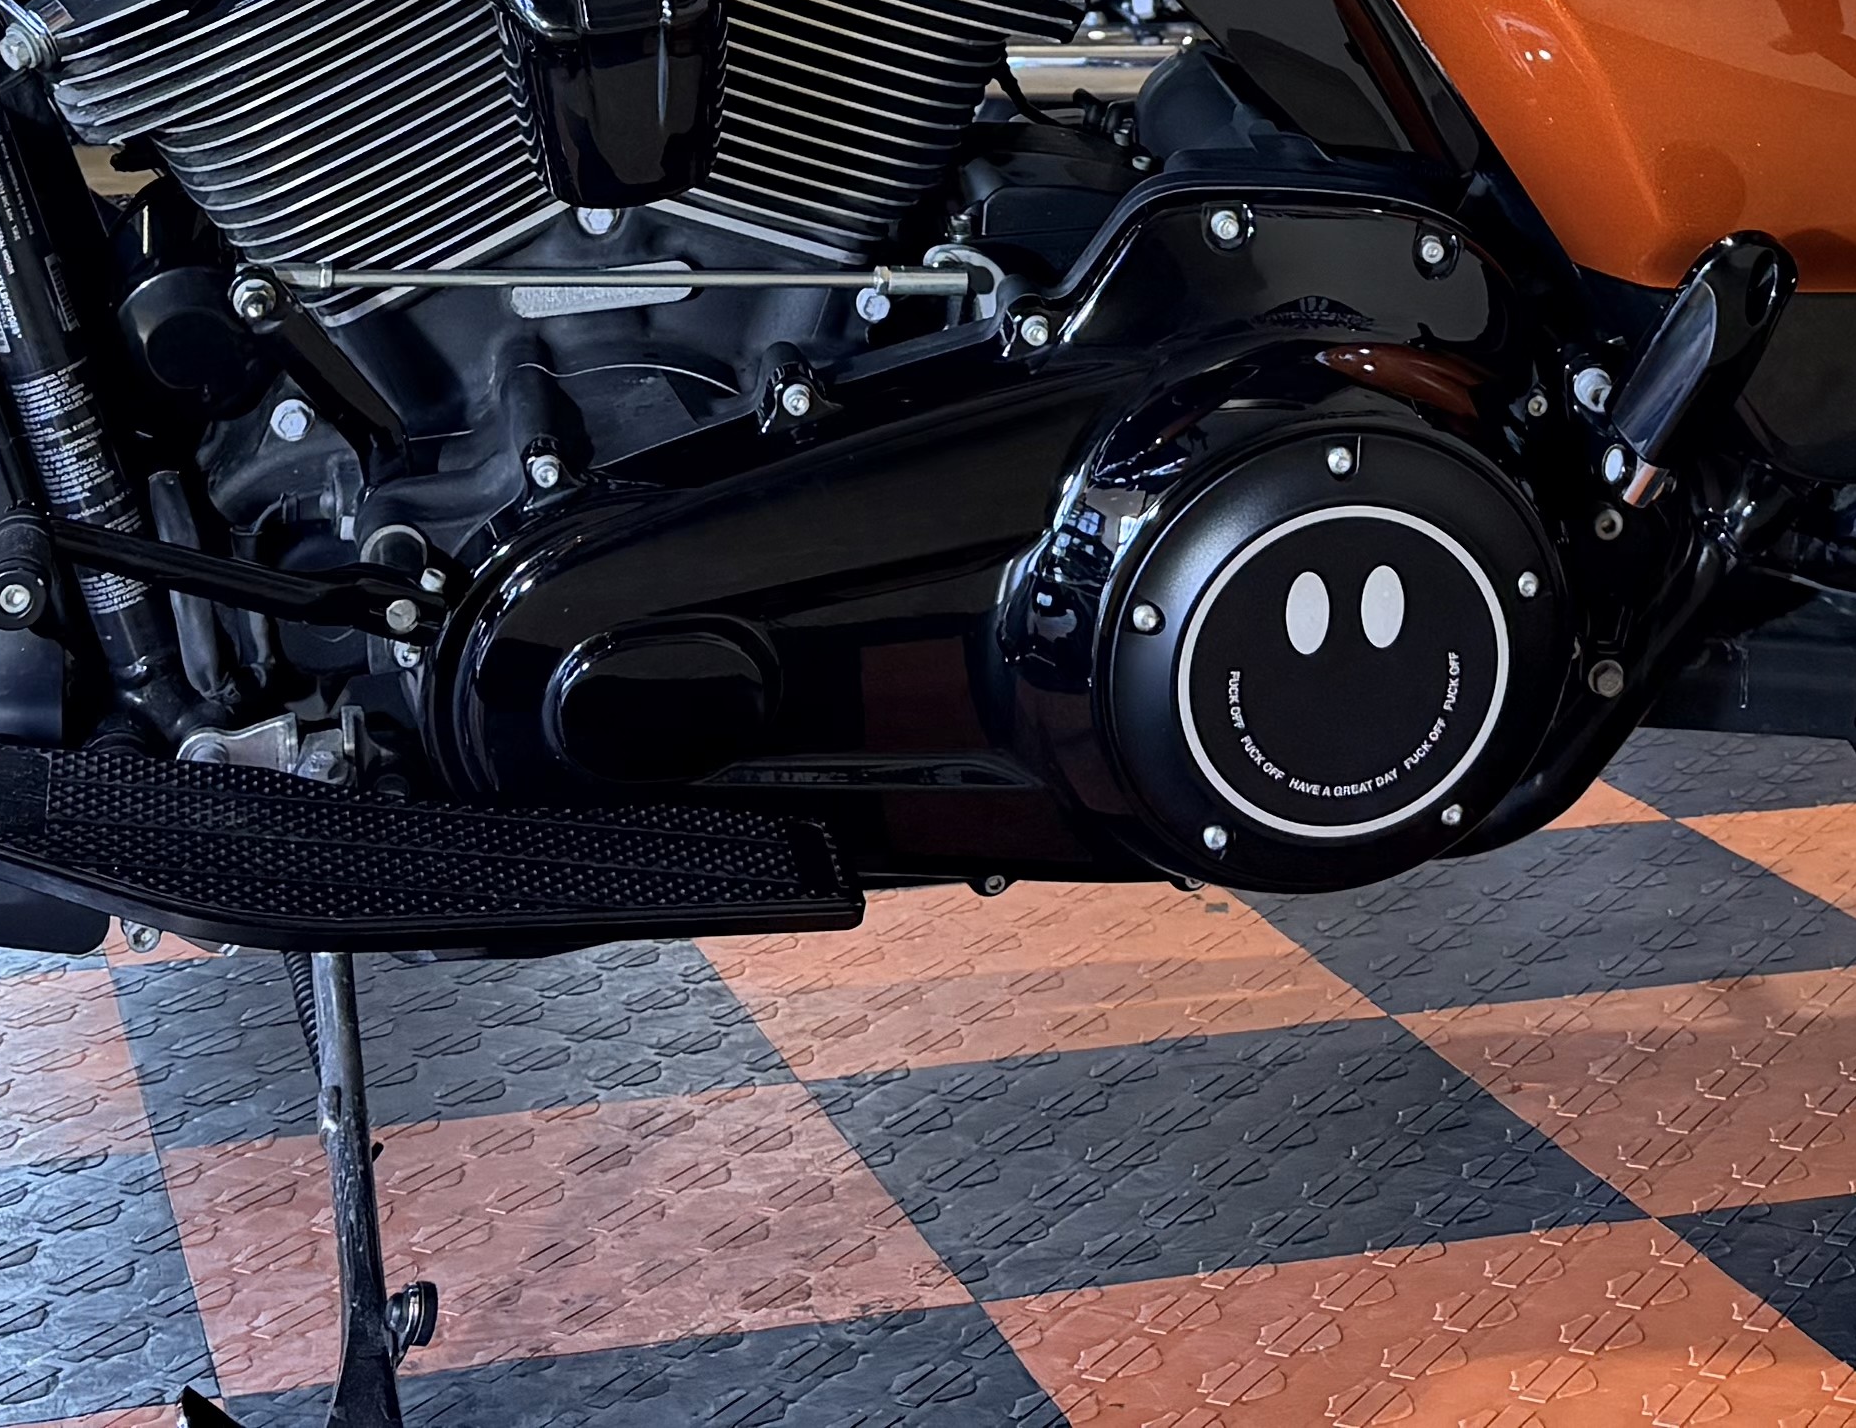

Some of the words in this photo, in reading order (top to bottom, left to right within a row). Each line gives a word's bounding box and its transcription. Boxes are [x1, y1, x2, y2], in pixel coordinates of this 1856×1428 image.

[1448, 651, 1461, 676] OFF
[1228, 670, 1241, 704] FUCK
[1443, 678, 1460, 712] FUCK
[1230, 707, 1245, 729] OFF
[1429, 717, 1446, 741] OFF
[1241, 735, 1265, 766] FUCK
[1403, 741, 1433, 770] FUCK
[1262, 762, 1286, 780] OFF
[1375, 768, 1398, 788] DAY
[1289, 777, 1321, 796] HAVE
[1322, 785, 1331, 797] A
[1333, 780, 1373, 797] GREAT
